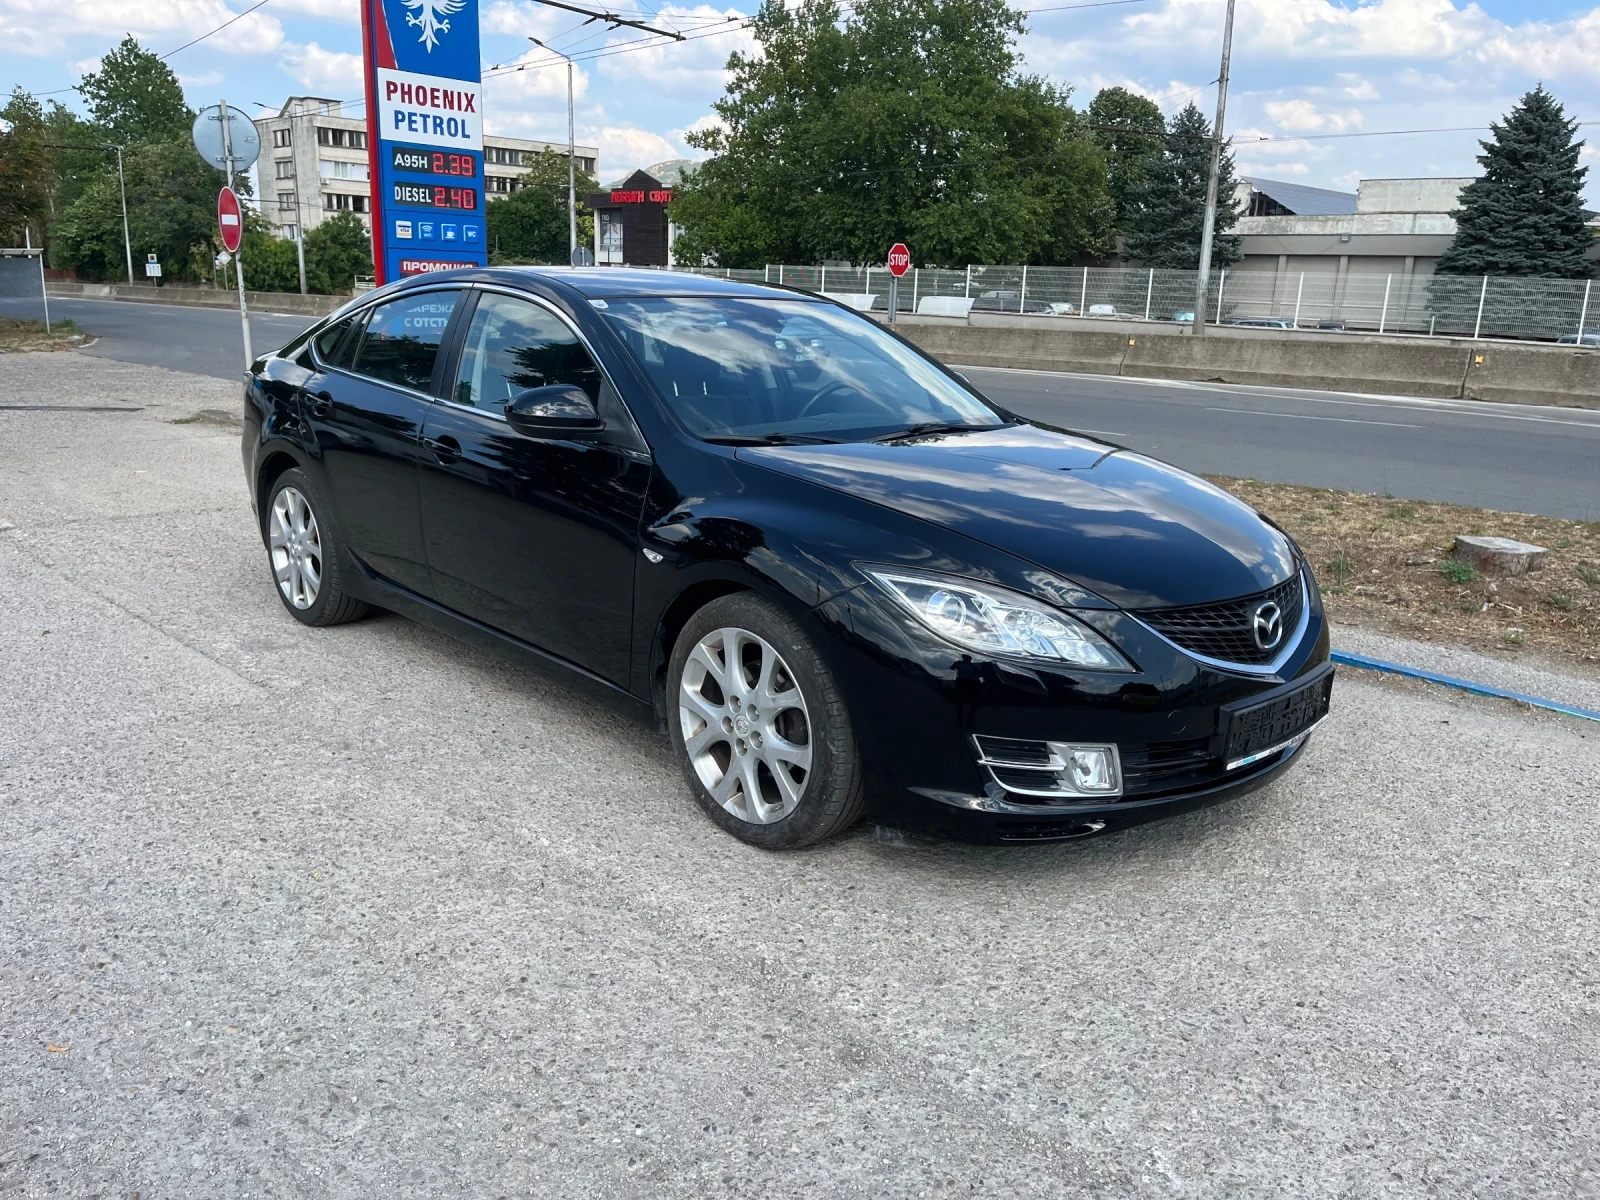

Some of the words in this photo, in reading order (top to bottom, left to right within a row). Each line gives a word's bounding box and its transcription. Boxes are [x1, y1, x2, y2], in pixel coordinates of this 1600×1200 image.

[386, 80, 476, 113] PHOENIX
[394, 109, 471, 139] PETROL
[394, 153, 428, 169] A95H
[433, 152, 473, 176] 2.39
[394, 186, 432, 203] DIESEL
[434, 187, 474, 209] 2.40
[890, 254, 908, 266] STOP
